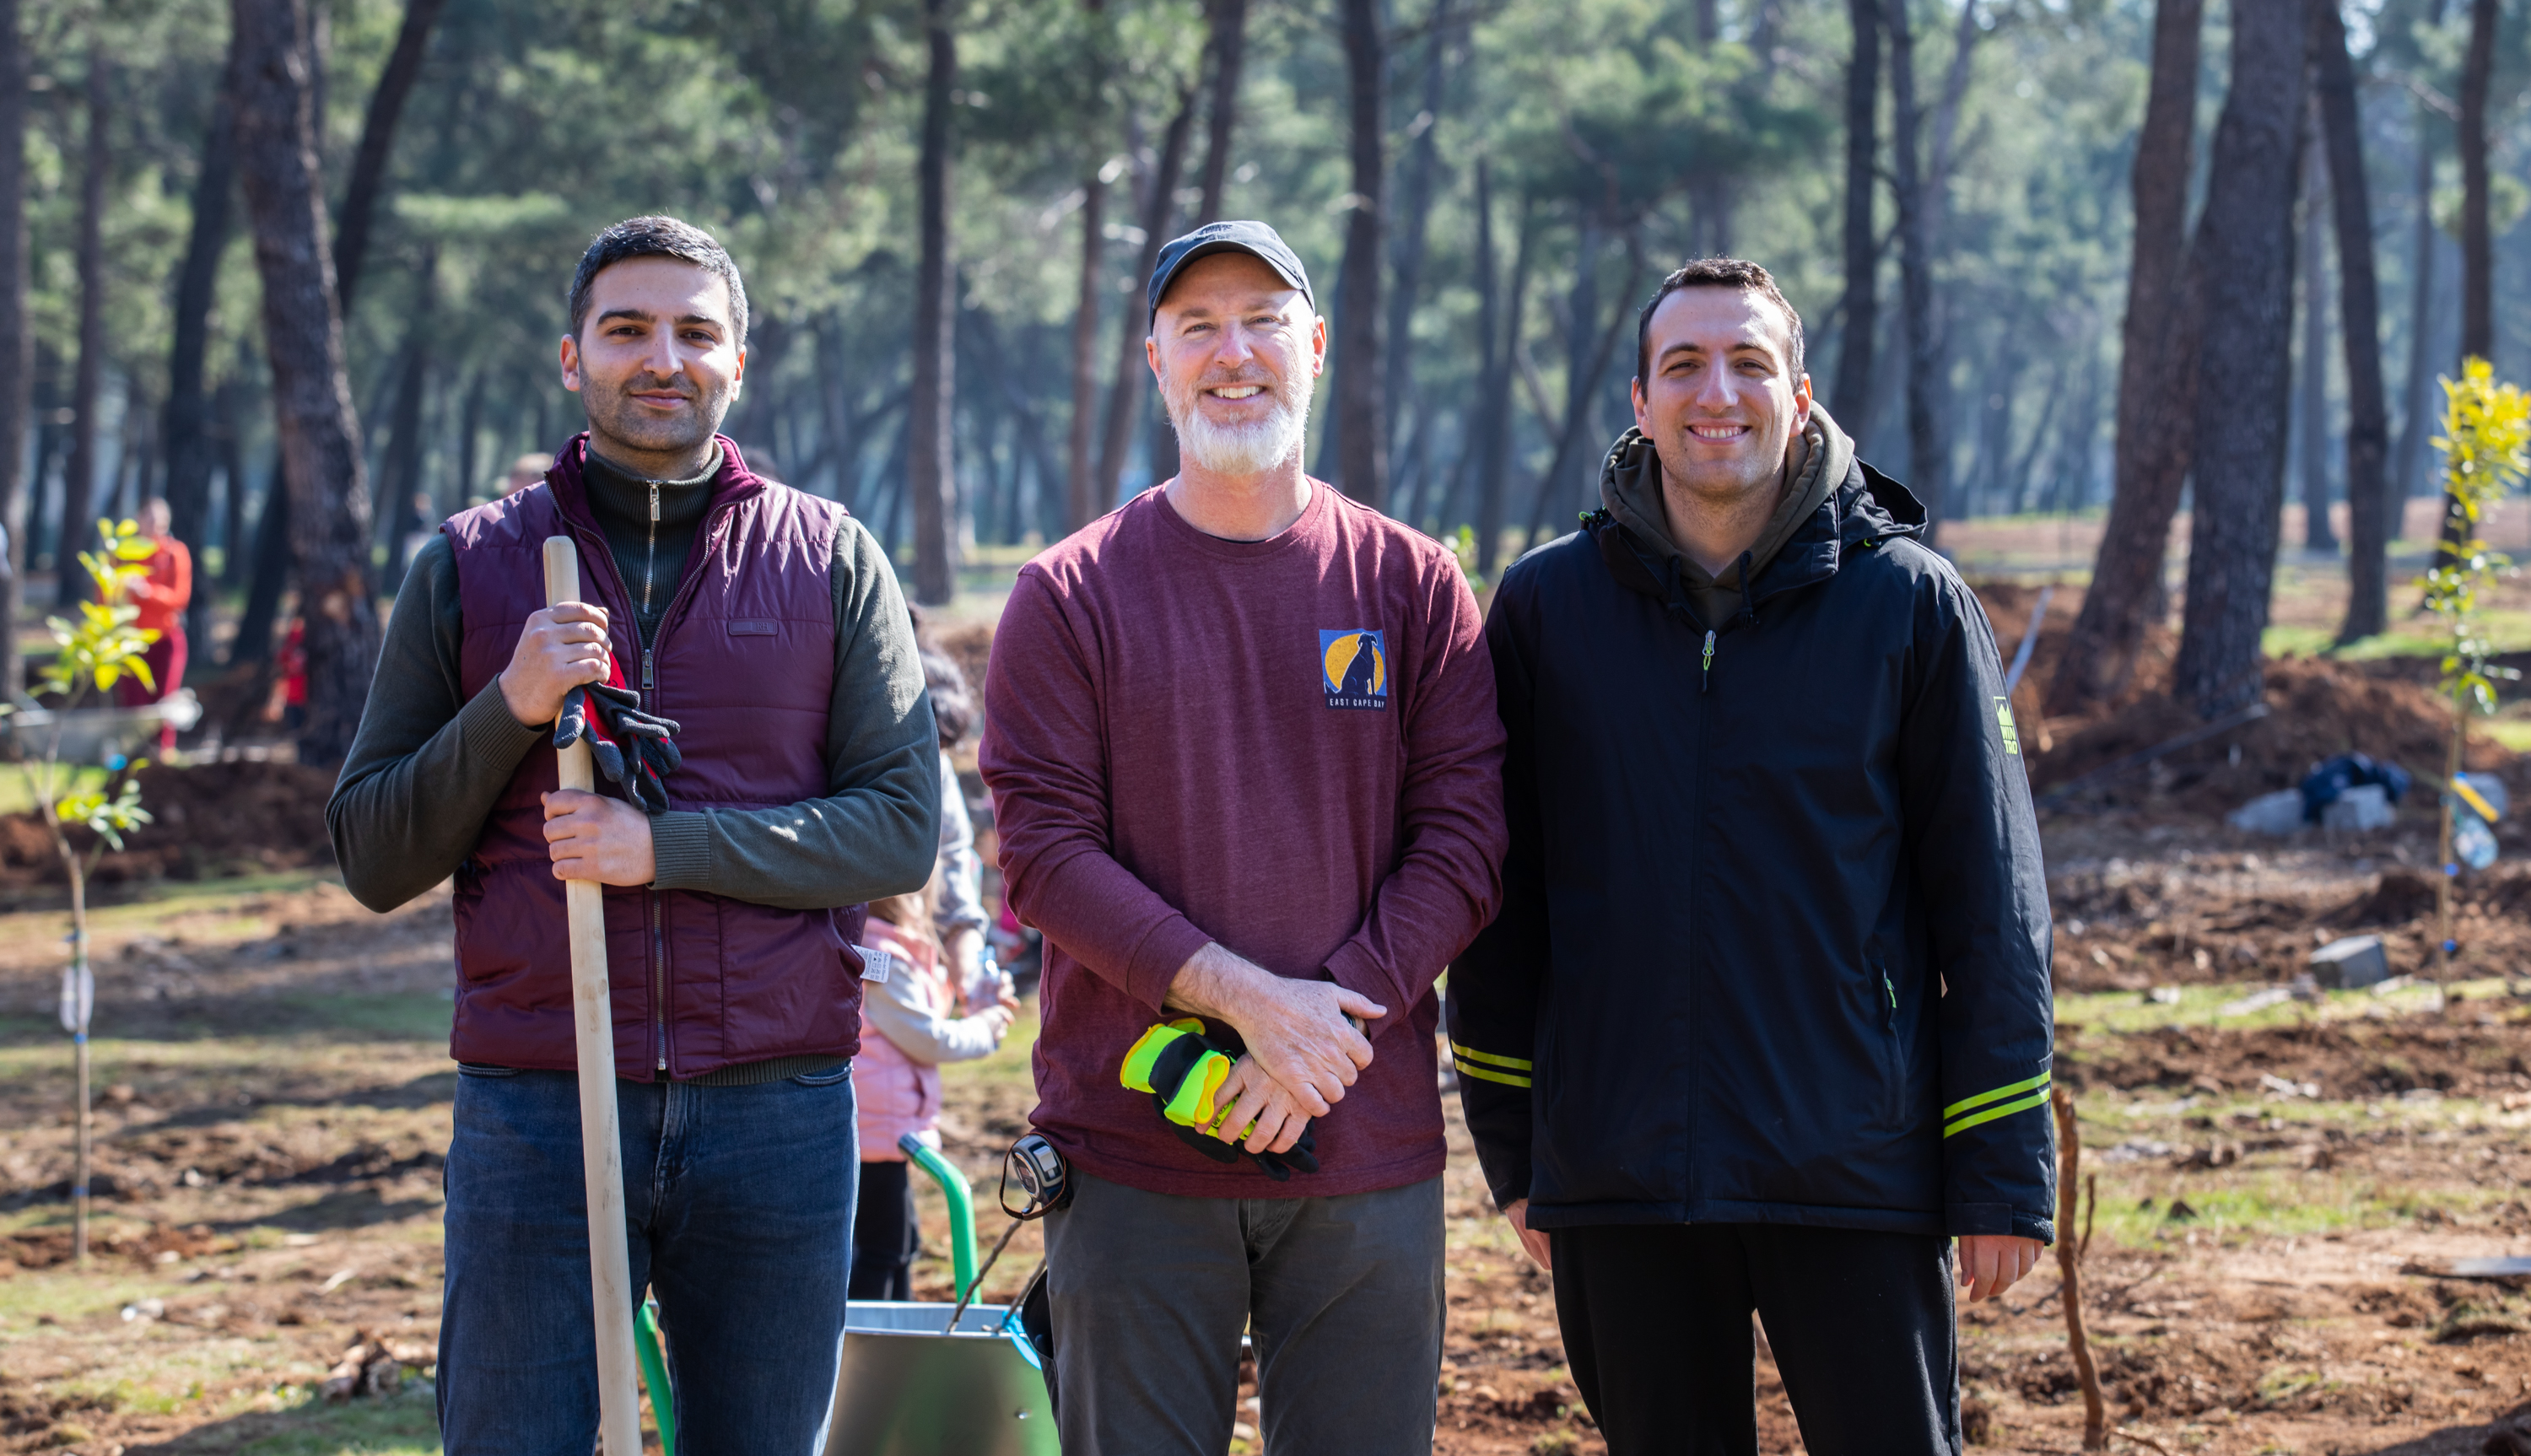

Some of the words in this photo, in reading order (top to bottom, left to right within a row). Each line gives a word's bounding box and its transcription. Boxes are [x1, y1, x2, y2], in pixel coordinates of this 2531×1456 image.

[1330, 698, 1349, 706] EAST
[1353, 698, 1371, 707] CAPE
[1373, 699, 1384, 708] BAY
[1999, 725, 2016, 740] WIN
[2003, 739, 2017, 754] TRO
